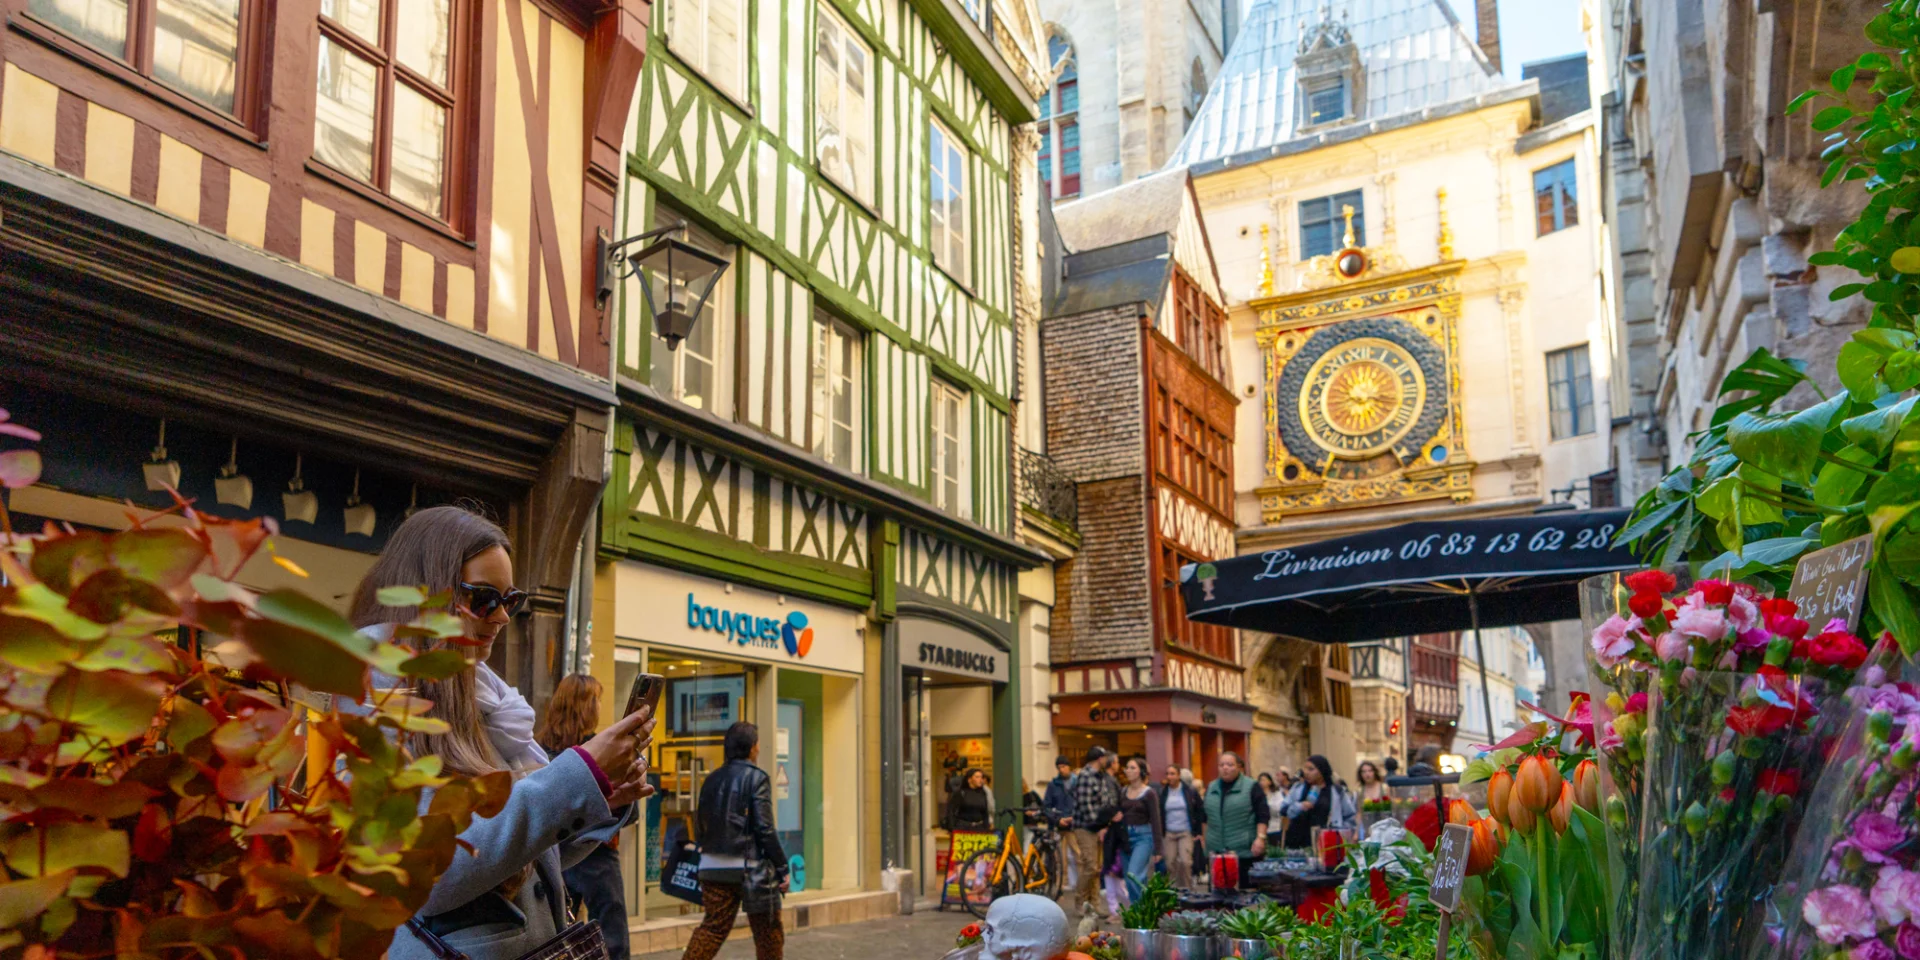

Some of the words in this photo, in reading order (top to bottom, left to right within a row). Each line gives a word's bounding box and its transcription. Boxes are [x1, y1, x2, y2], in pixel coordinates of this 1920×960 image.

[1253, 545, 1393, 581] Livraison
[1400, 534, 1443, 561] 06
[1439, 532, 1477, 556] 83
[1484, 533, 1520, 554] 13
[1528, 527, 1566, 552] 62
[1570, 523, 1615, 550] 28
[687, 592, 781, 646] bouygues
[918, 641, 995, 674] STARBUCKS
